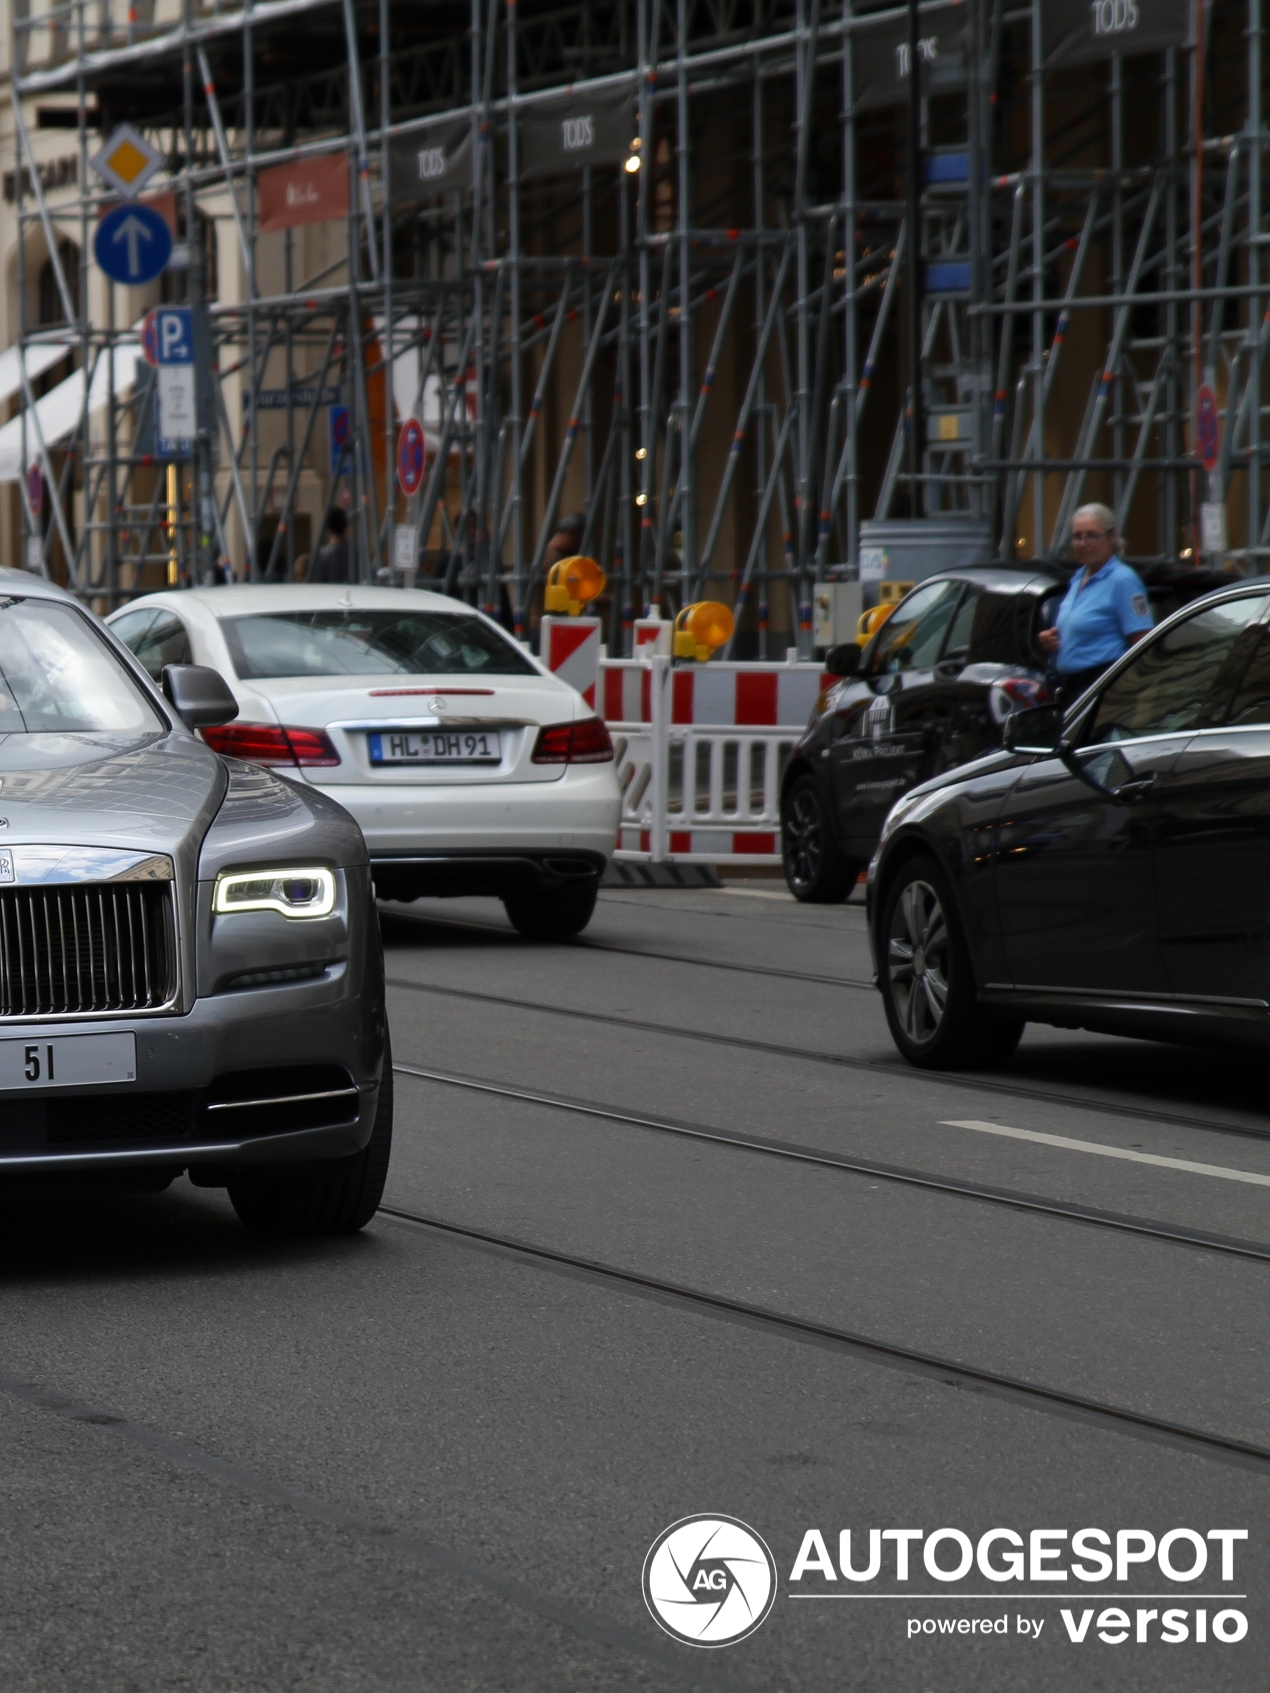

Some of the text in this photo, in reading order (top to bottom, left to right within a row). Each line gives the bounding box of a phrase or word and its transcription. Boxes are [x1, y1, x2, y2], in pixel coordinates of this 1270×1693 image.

[161, 315, 183, 359] P
[390, 735, 491, 757] HL DH 91
[24, 1043, 55, 1082] 51
